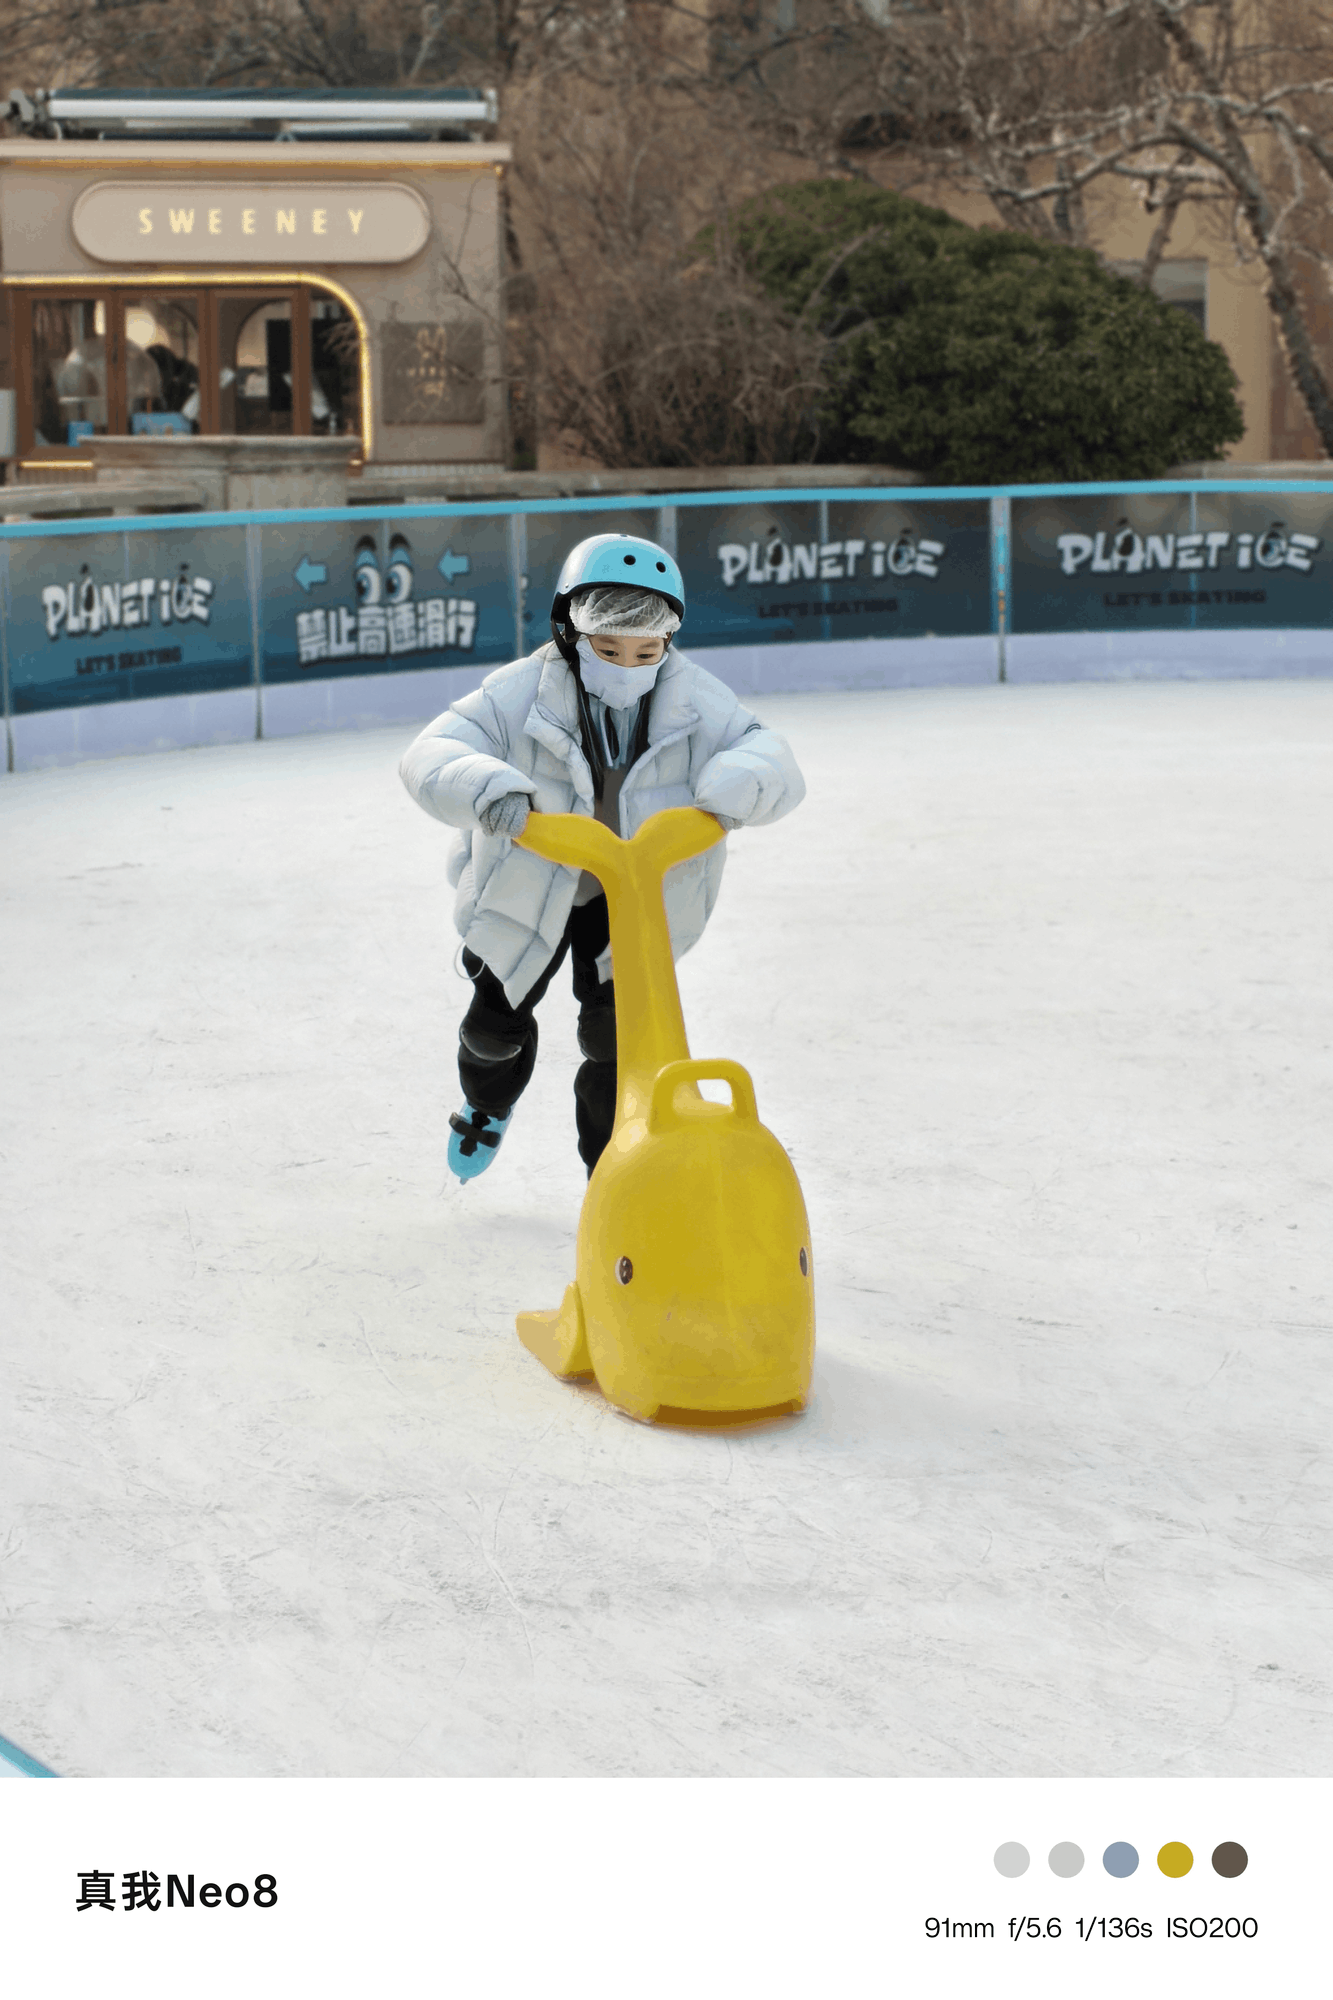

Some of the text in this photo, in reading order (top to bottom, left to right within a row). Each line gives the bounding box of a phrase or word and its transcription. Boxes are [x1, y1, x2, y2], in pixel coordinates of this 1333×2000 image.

[138, 208, 364, 235] SWEENEY
[718, 537, 866, 586] PLANET
[1057, 528, 1231, 575] PLANET
[42, 576, 156, 637] PLANET
[296, 598, 477, 664] 禁止高速滑行
